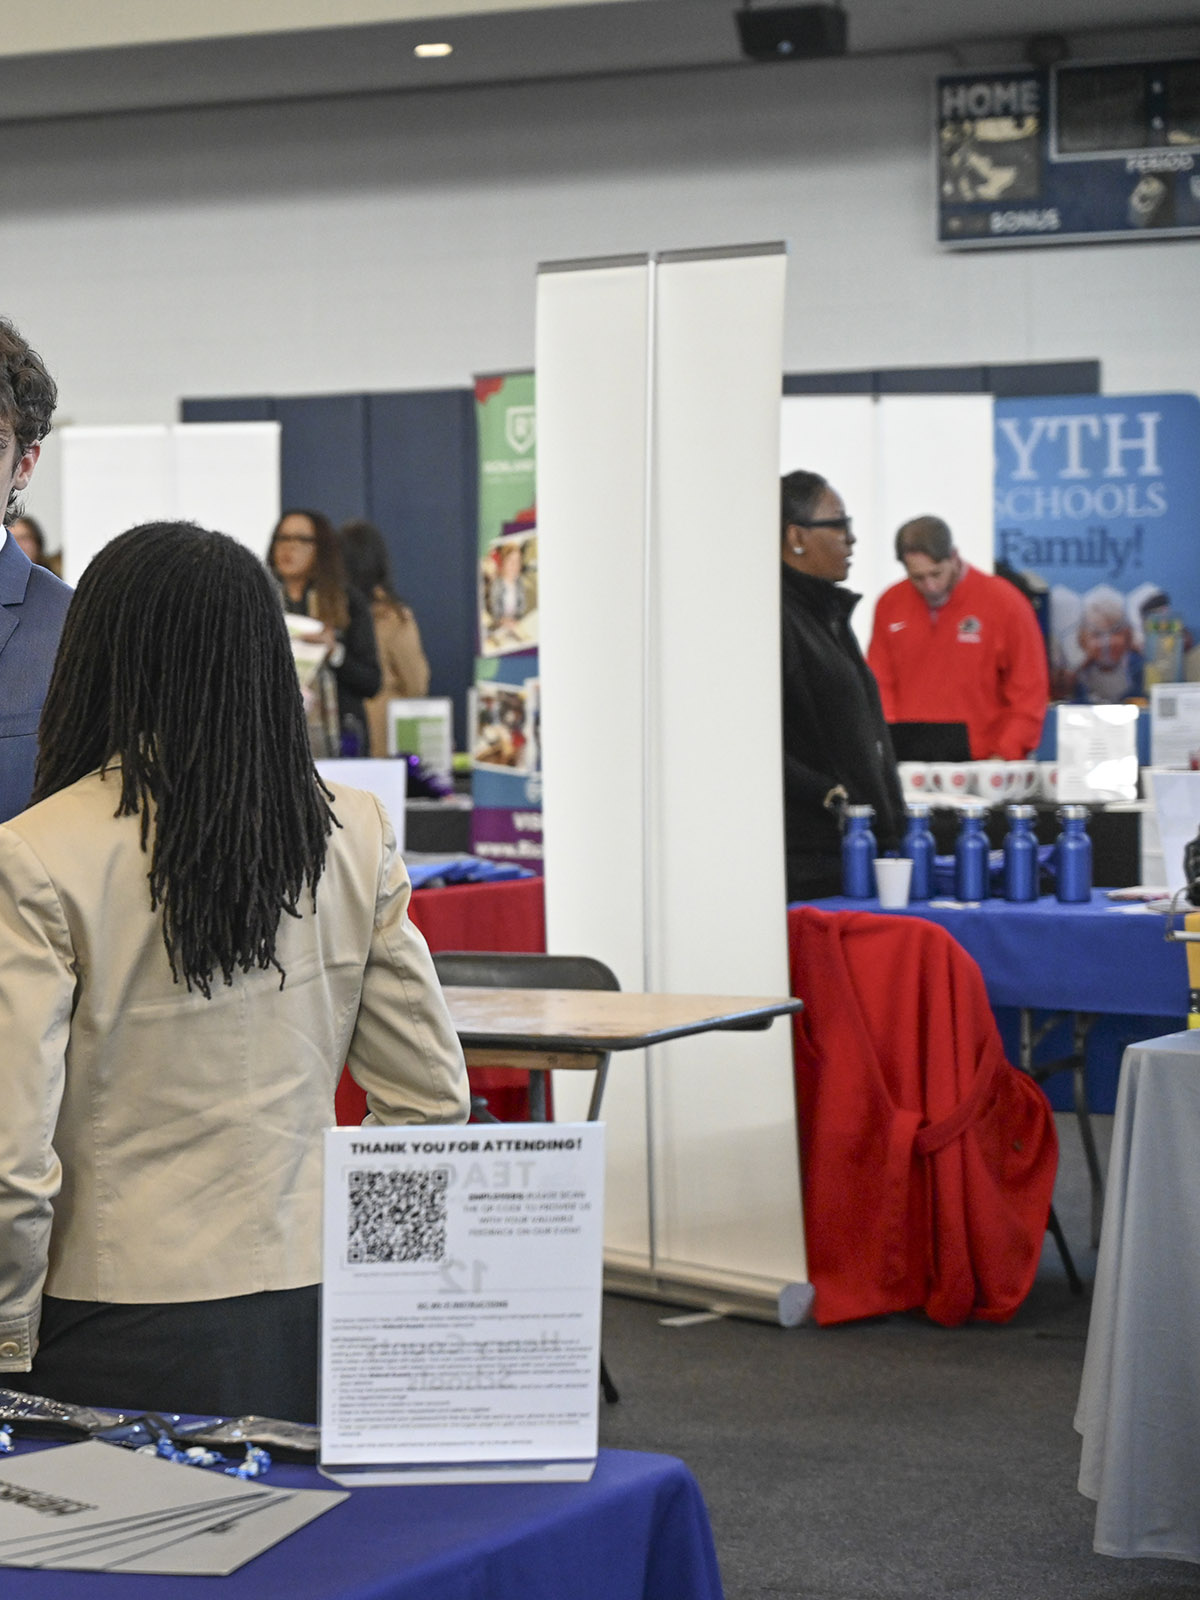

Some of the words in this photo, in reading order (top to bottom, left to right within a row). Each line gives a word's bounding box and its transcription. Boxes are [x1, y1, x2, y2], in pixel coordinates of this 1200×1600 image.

[942, 80, 1040, 118] HOME
[990, 208, 1061, 234] BONUS
[995, 412, 1163, 482] YTH
[999, 526, 1145, 578] Family!
[350, 1142, 407, 1155] THANK
[412, 1142, 446, 1154] YOU
[447, 1141, 479, 1153] FOR
[483, 1137, 583, 1152] ATTENDING!
